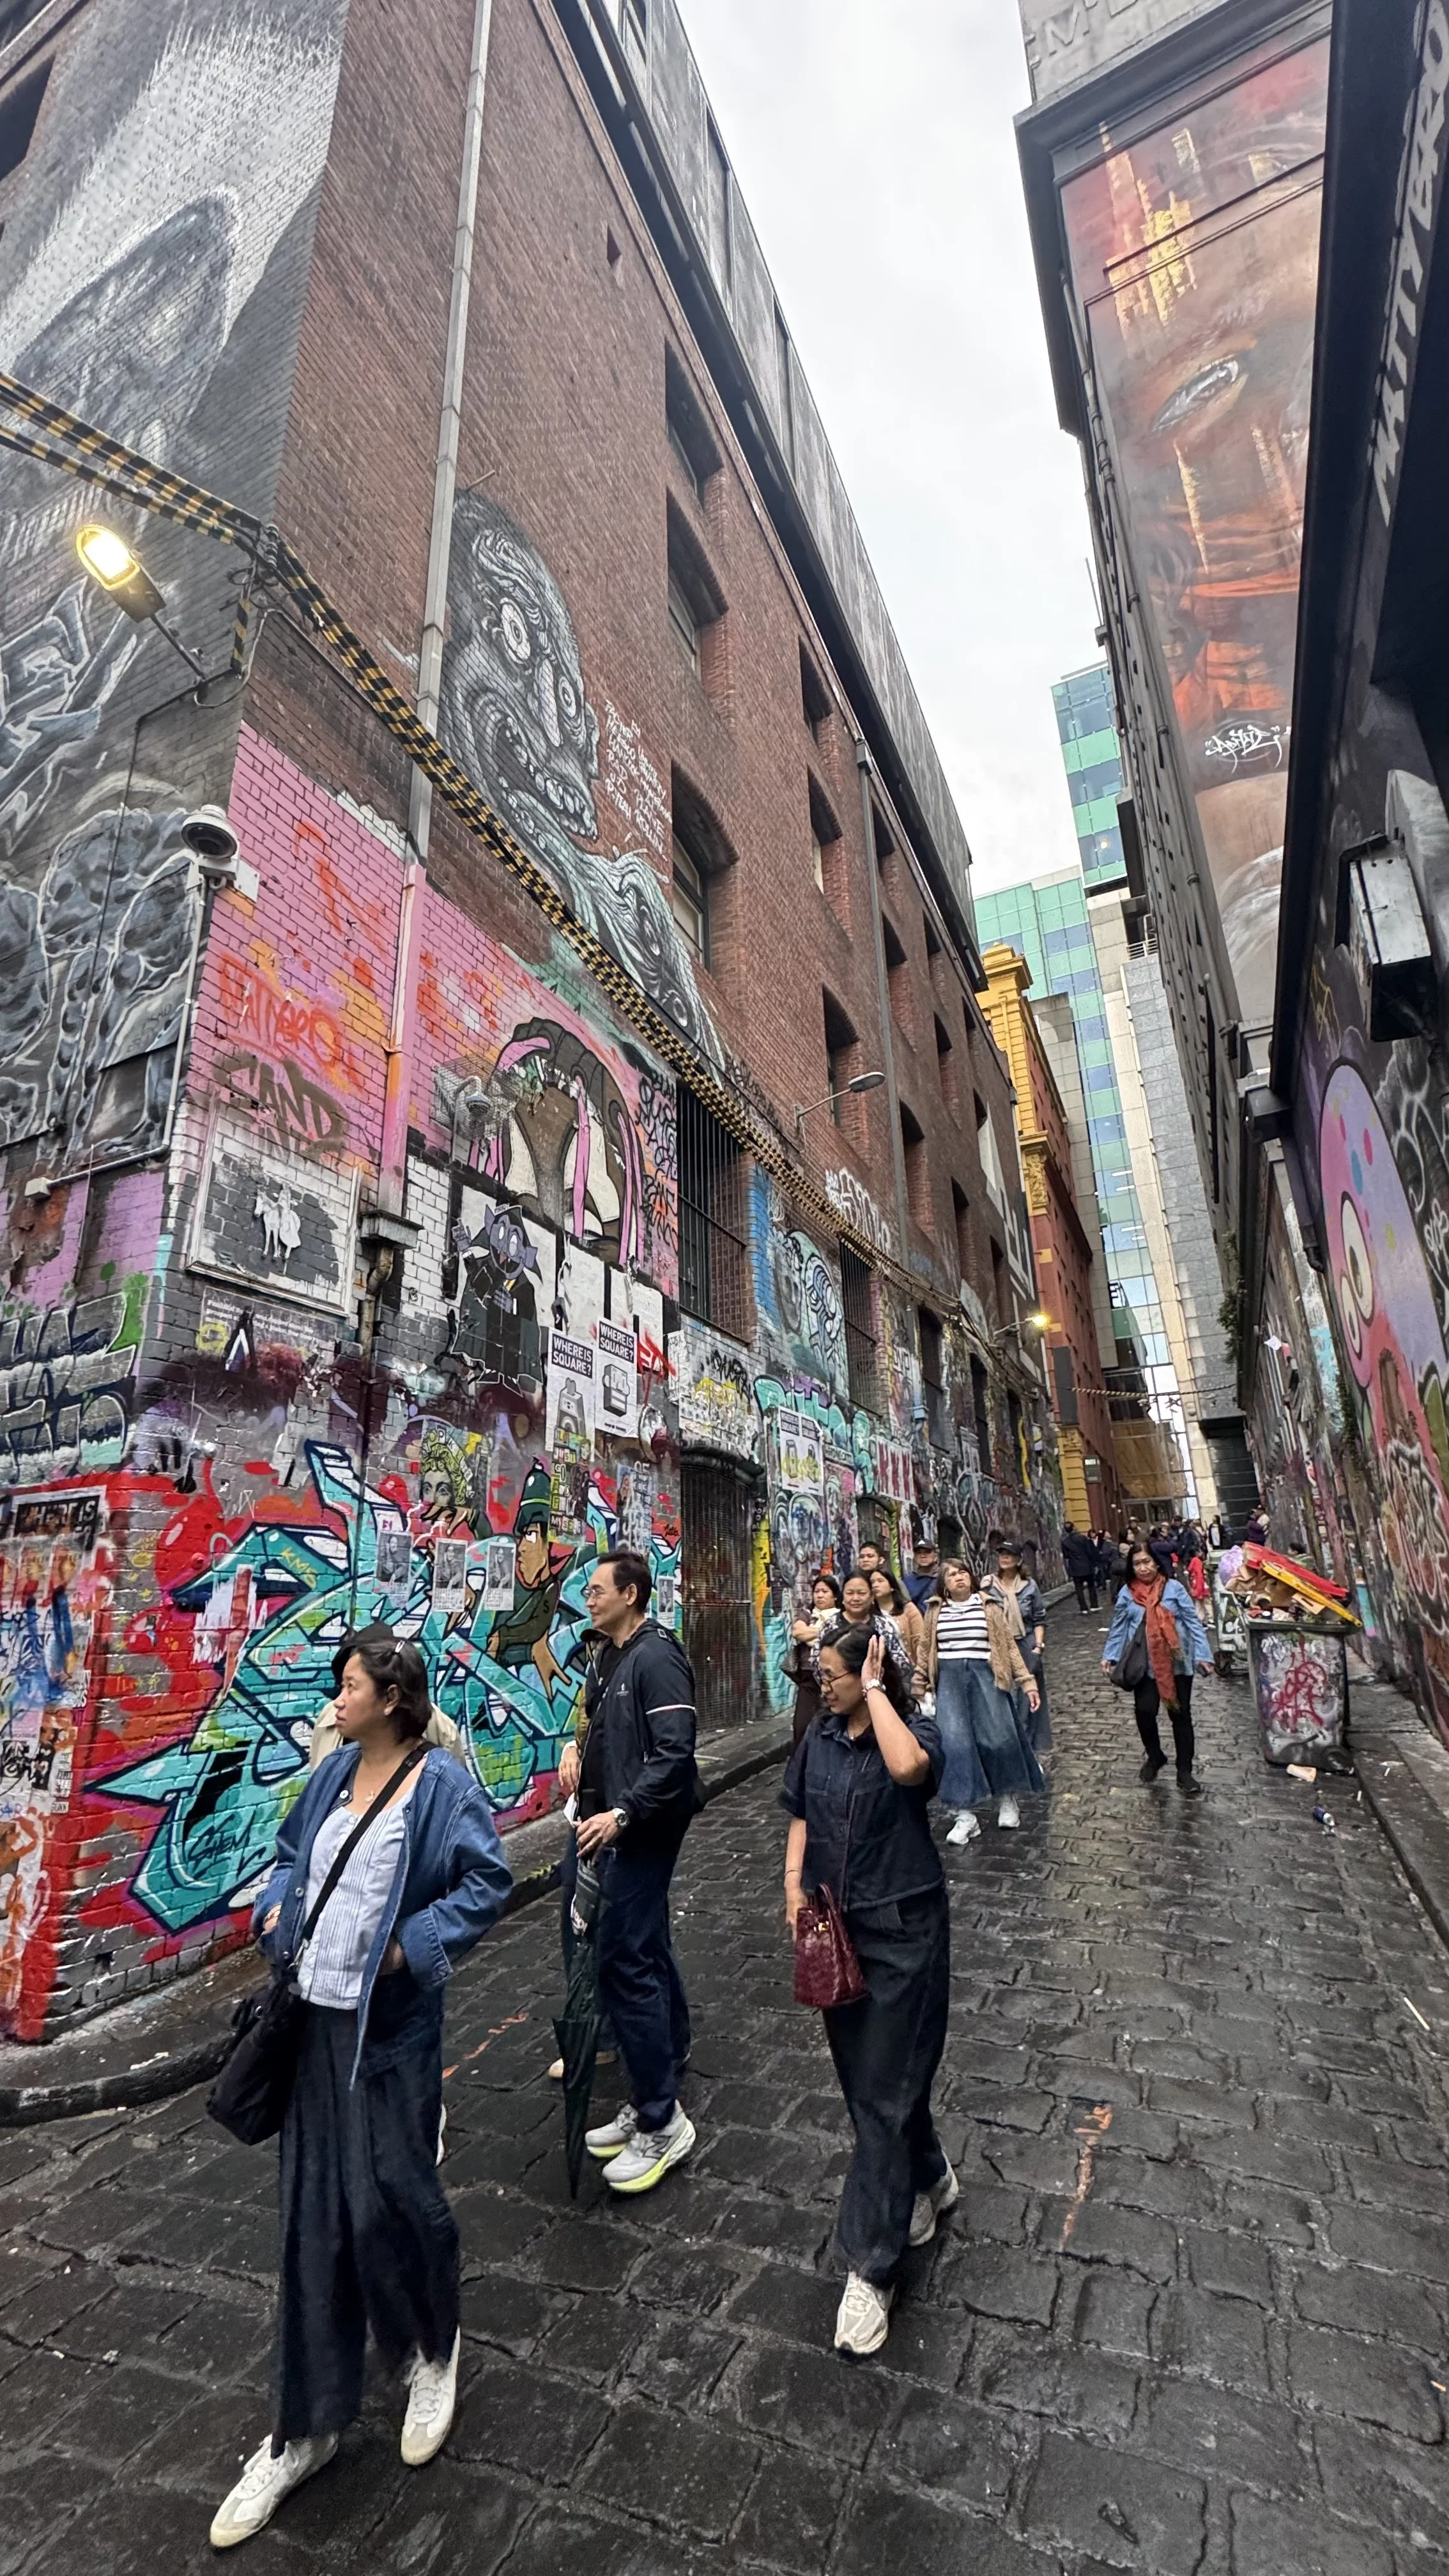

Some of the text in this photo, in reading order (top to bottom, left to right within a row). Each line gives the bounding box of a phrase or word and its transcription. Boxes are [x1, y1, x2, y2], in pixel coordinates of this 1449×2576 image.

[600, 1323, 634, 1349] WHERE IS
[600, 1337, 634, 1360] SQUARE?
[553, 1336, 592, 1363] WHERE IS
[553, 1351, 592, 1377] SQUARE?
